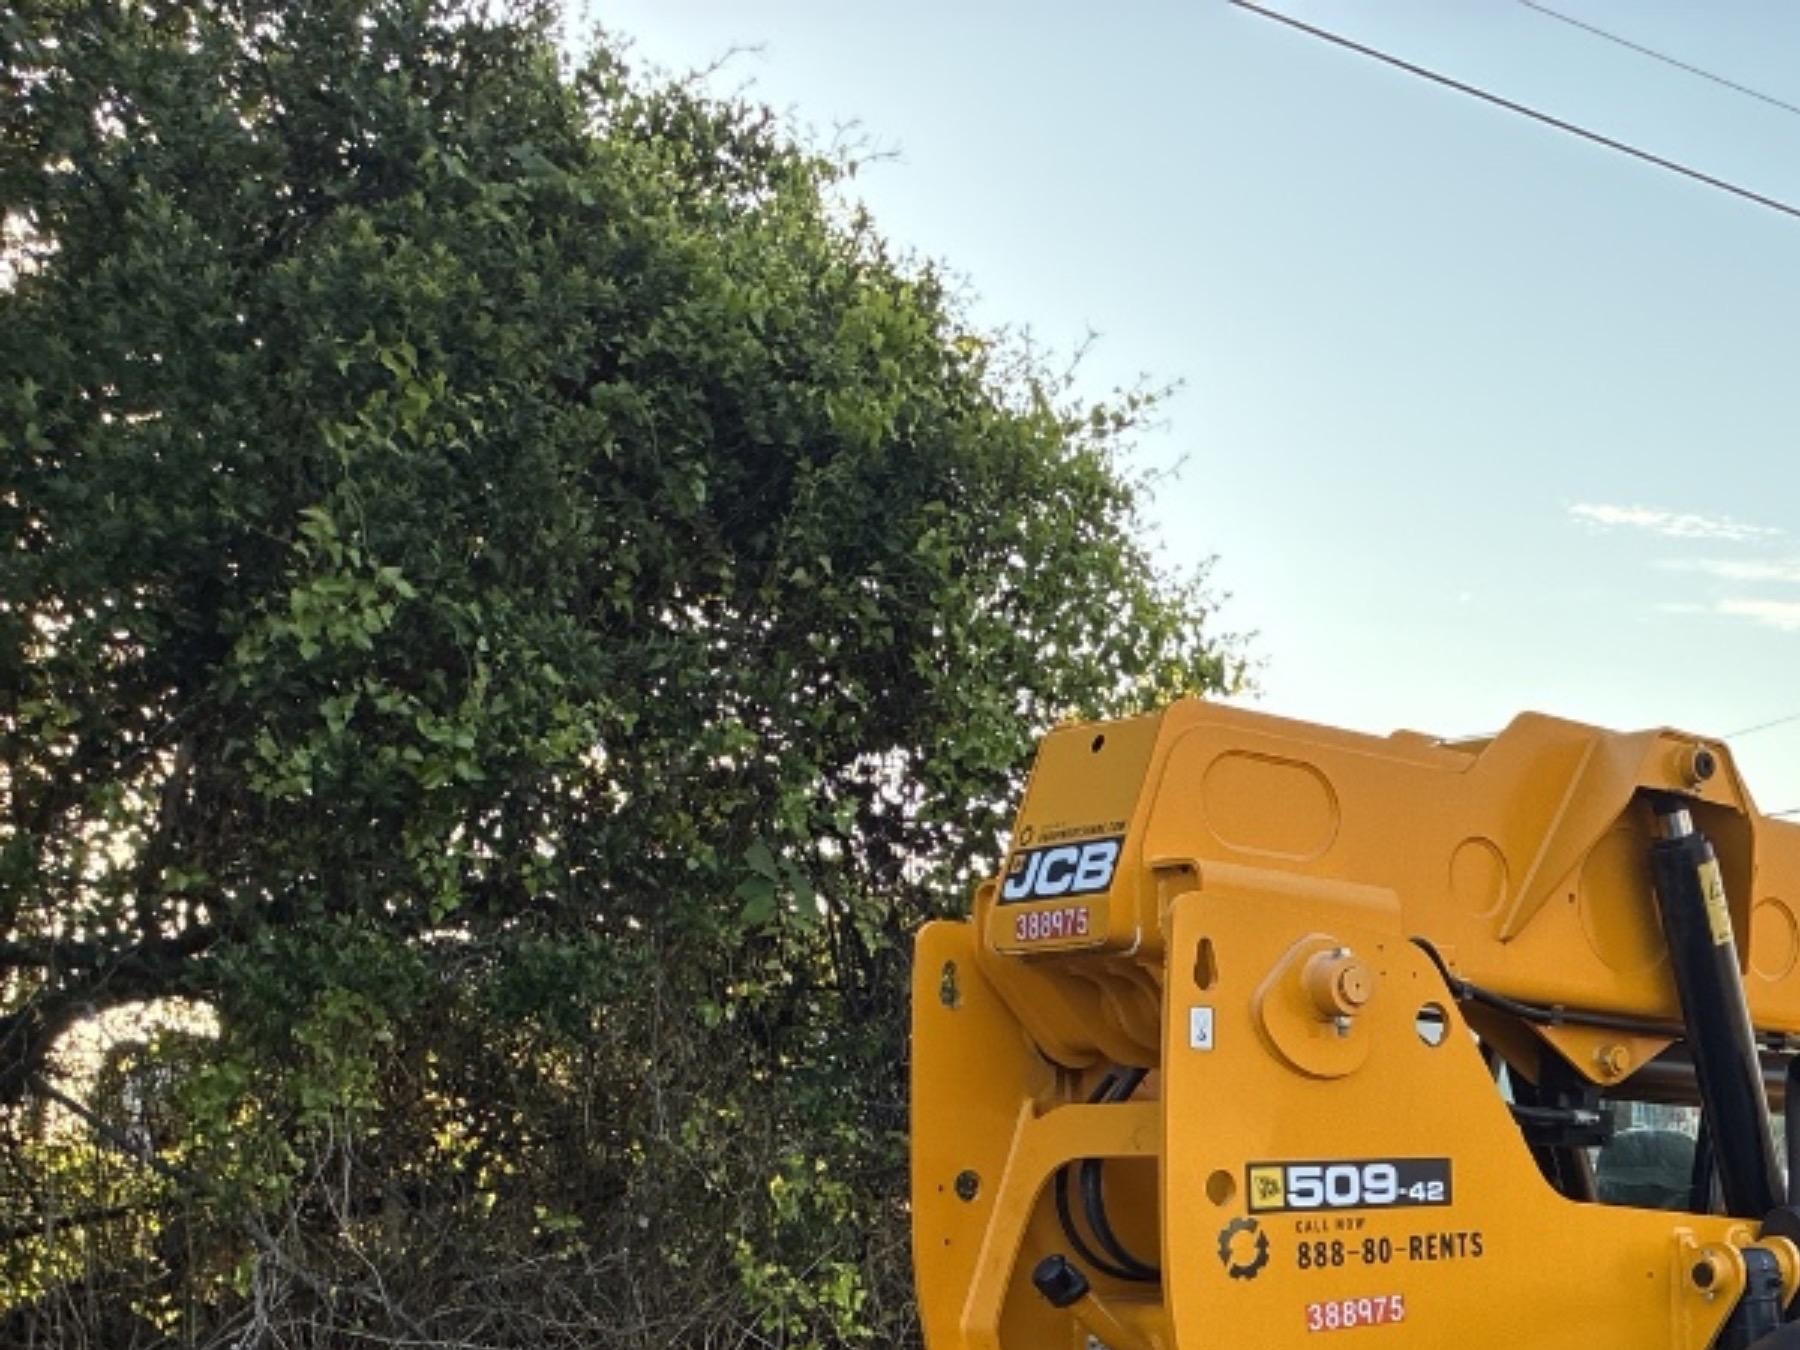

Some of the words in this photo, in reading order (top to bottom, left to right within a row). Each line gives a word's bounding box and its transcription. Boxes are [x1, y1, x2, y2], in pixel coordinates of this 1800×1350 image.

[1003, 840, 1119, 900] JCB
[1015, 906, 1090, 940] 388975
[1295, 1219, 1330, 1234] CALL
[1334, 1217, 1367, 1231] NOW
[1297, 1231, 1484, 1270] 888-80-RENTS
[1308, 1294, 1405, 1332] 388975
